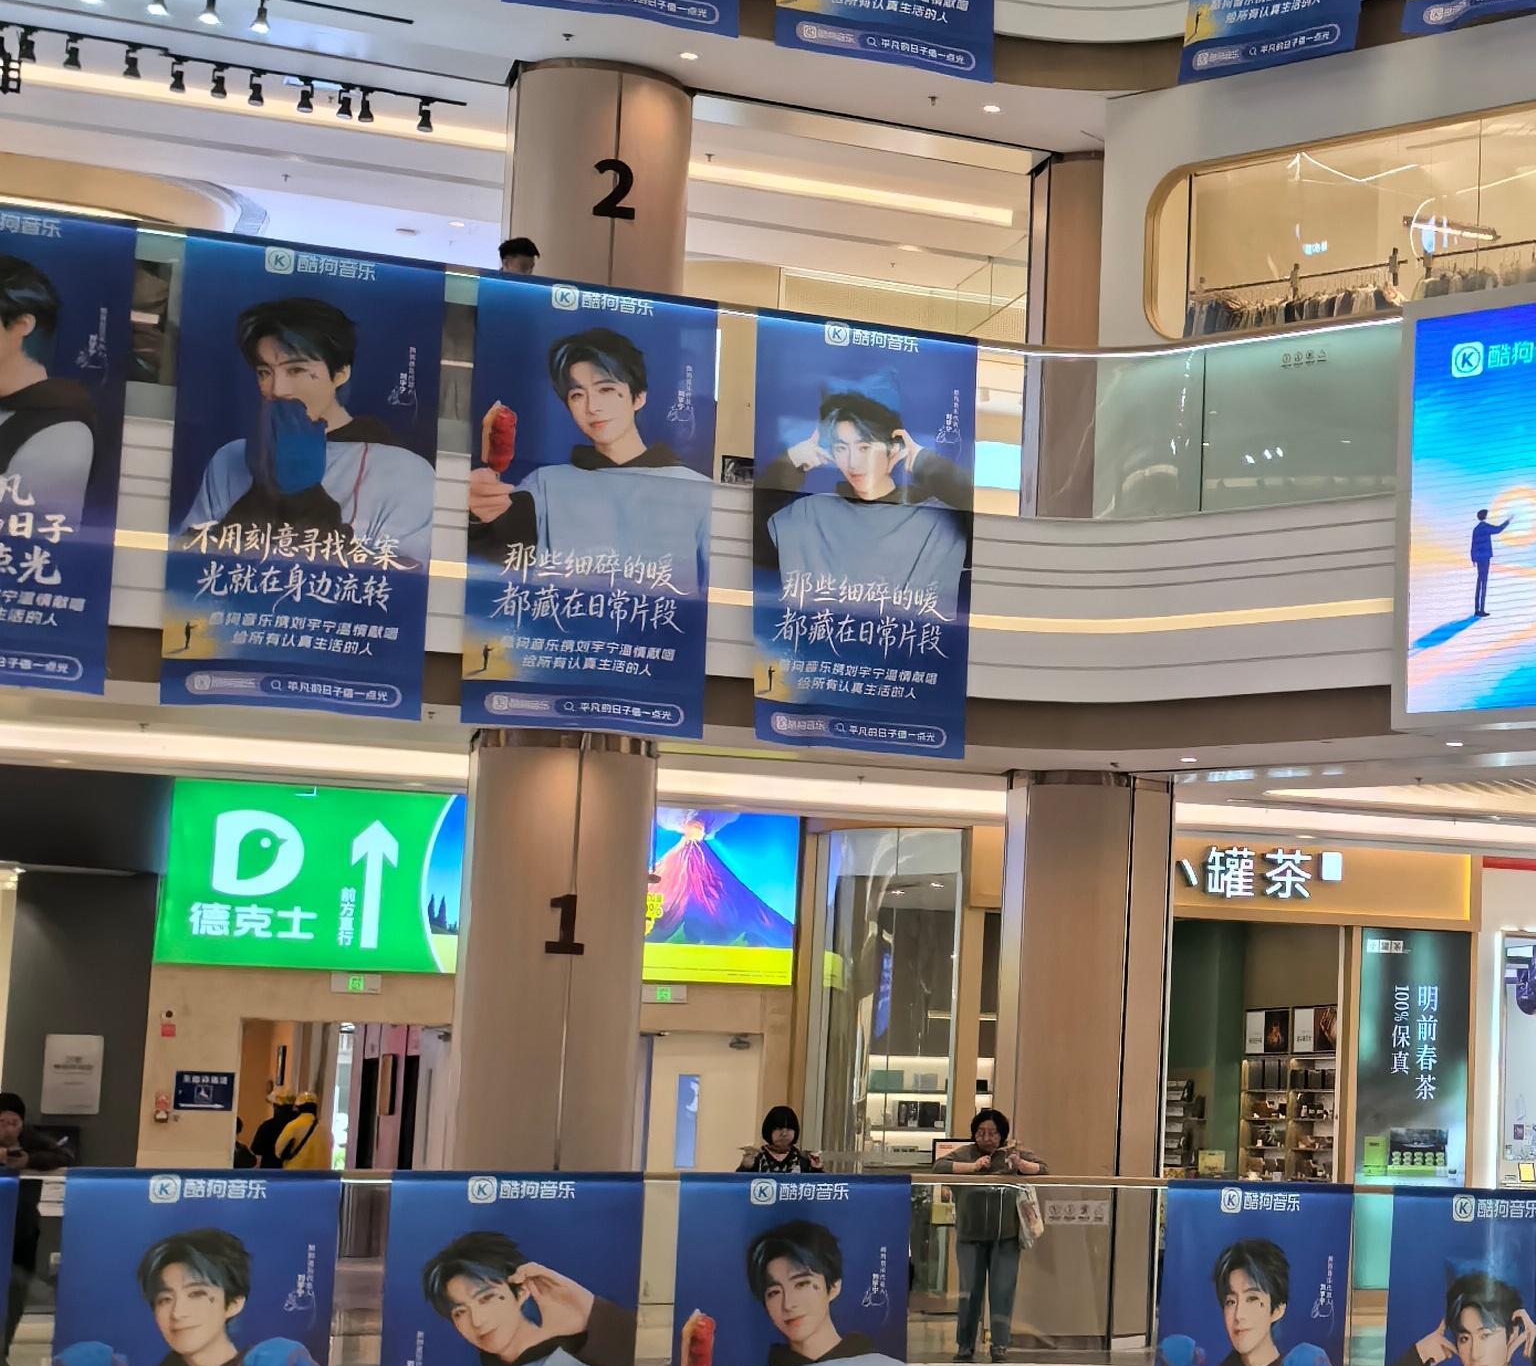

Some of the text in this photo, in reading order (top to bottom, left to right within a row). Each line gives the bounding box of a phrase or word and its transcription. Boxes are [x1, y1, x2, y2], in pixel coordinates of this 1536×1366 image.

[593, 159, 635, 219] 2
[582, 291, 654, 317] 酷狗音乐
[852, 327, 919, 353] 酷狗音乐
[182, 522, 422, 570] 不用刻意寻找答案
[501, 543, 688, 595] 那些细碎的暖
[194, 567, 393, 616] 光就在身边流转
[488, 585, 685, 635] 都藏在日常片段
[779, 570, 953, 623] 那些细碎的暖
[773, 611, 947, 660] 都藏在日常片段
[523, 654, 652, 678] 给所有认真生活的人
[798, 677, 918, 700] 给所有认真生活的人
[190, 903, 317, 940] 德克士
[337, 887, 357, 946] 前方直行
[545, 894, 584, 955] 1
[1391, 985, 1410, 1075] 100%保真
[1416, 986, 1438, 1100] 明前春茶
[183, 1179, 266, 1199] 酷狗音乐
[499, 1180, 575, 1201] 酷狗音乐
[779, 1182, 849, 1201] 酷狗音乐
[1244, 1192, 1300, 1212] 酷狗音乐
